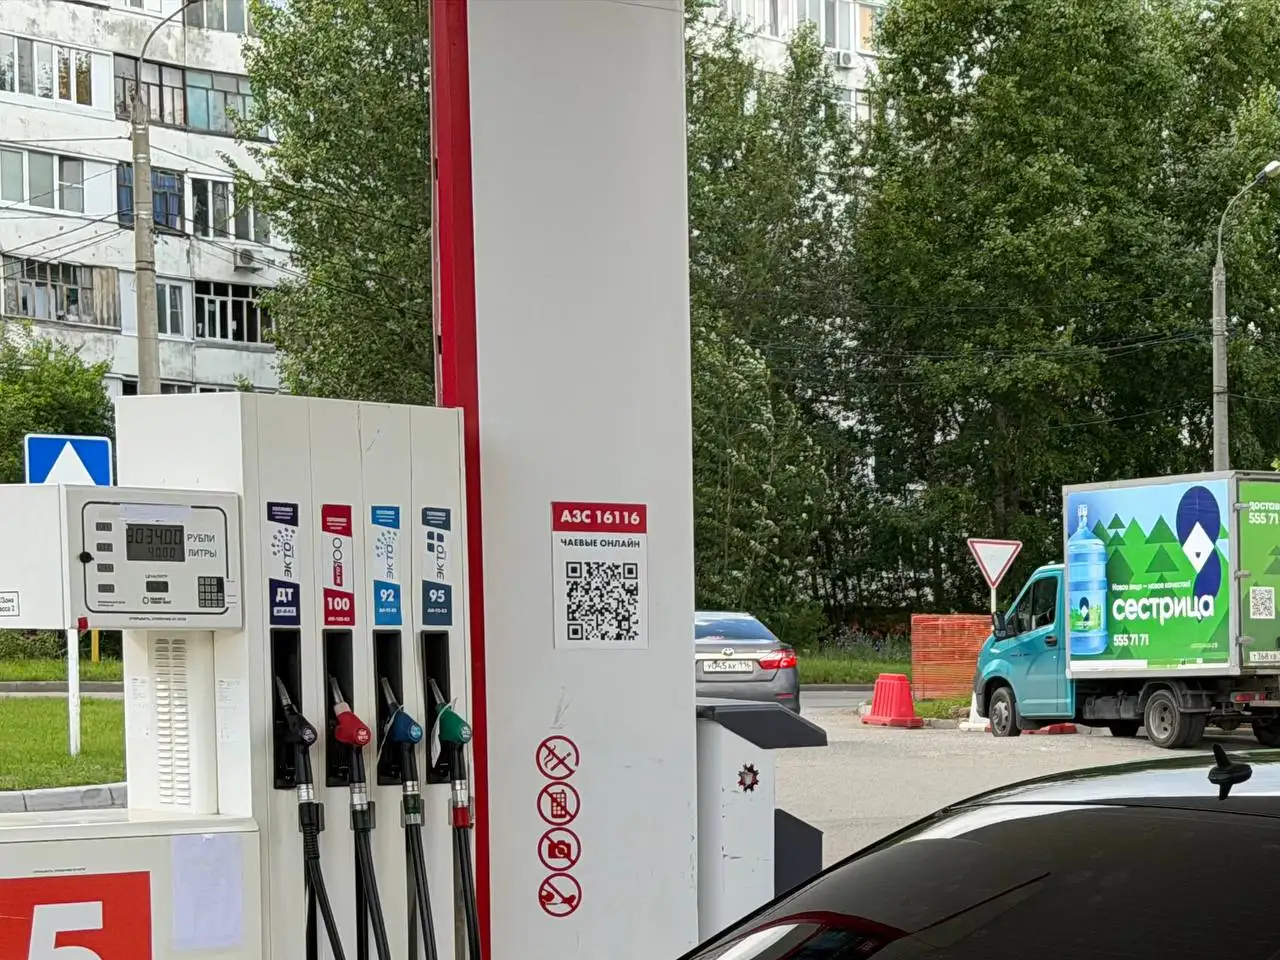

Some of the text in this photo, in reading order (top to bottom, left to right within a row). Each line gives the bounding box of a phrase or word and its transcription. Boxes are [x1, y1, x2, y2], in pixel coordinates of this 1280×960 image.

[560, 509, 641, 526] АЗС 16116
[1248, 512, 1267, 525] 555
[1267, 512, 1279, 525] 71
[186, 533, 216, 543] РУБЛИ
[560, 537, 641, 549] ЧАЕВЫЕ ОНЛАЙН
[187, 548, 217, 558] ЛИТРЫ
[386, 544, 395, 580] ЭКТО
[436, 544, 446, 581] ЭКТО
[275, 587, 294, 604] ДТ
[379, 588, 395, 602] 92
[429, 588, 446, 603] 95
[327, 597, 351, 611] 100
[1112, 594, 1215, 626] сестрица
[1113, 633, 1149, 647] 555 71 71
